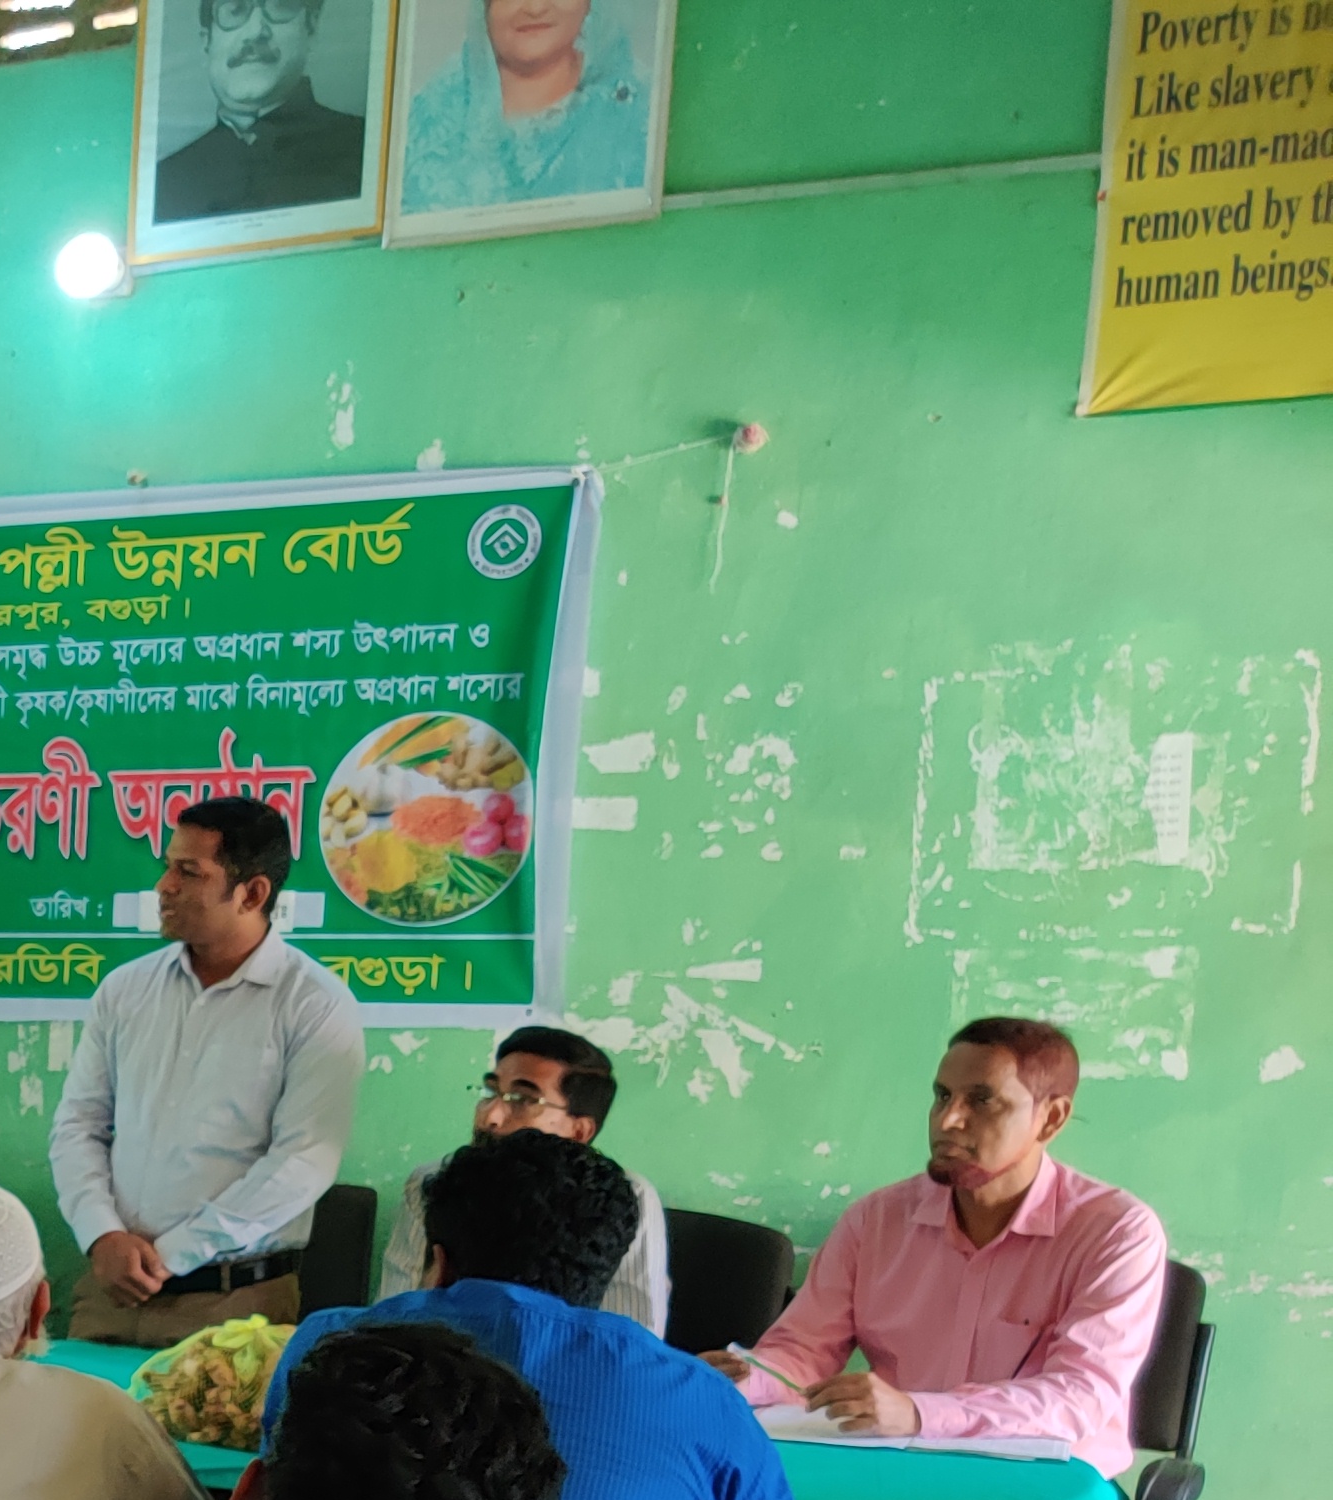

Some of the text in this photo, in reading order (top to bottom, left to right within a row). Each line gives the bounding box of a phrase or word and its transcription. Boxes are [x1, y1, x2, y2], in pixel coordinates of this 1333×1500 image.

[1137, 1, 1259, 54] Poverty
[1268, 0, 1291, 36] is
[1130, 71, 1200, 119] Like
[1208, 63, 1320, 108] slavery
[1125, 138, 1147, 182] it
[1156, 134, 1181, 178] is
[1120, 189, 1253, 245] removed
[1262, 185, 1303, 240] by
[1114, 265, 1219, 308] human
[107, 525, 266, 591] উন্নয়ন
[283, 503, 415, 574] বোর্ড
[84, 595, 171, 625] বগুড়া
[56, 634, 104, 666] উচ্চ
[110, 637, 186, 674] মূল্যের
[193, 631, 283, 662] অপ্রধান
[290, 629, 344, 659] শস্য
[352, 620, 459, 655] উৎপাদন
[469, 622, 490, 649] ও
[14, 677, 178, 728] কৃষক/কৃষাণীদের
[185, 683, 239, 711] মাঝে
[246, 674, 347, 717] বিনামূল্যে
[354, 676, 439, 707] অপ্রধান
[446, 672, 525, 703] শস্যের
[30, 890, 90, 921] তারিখ
